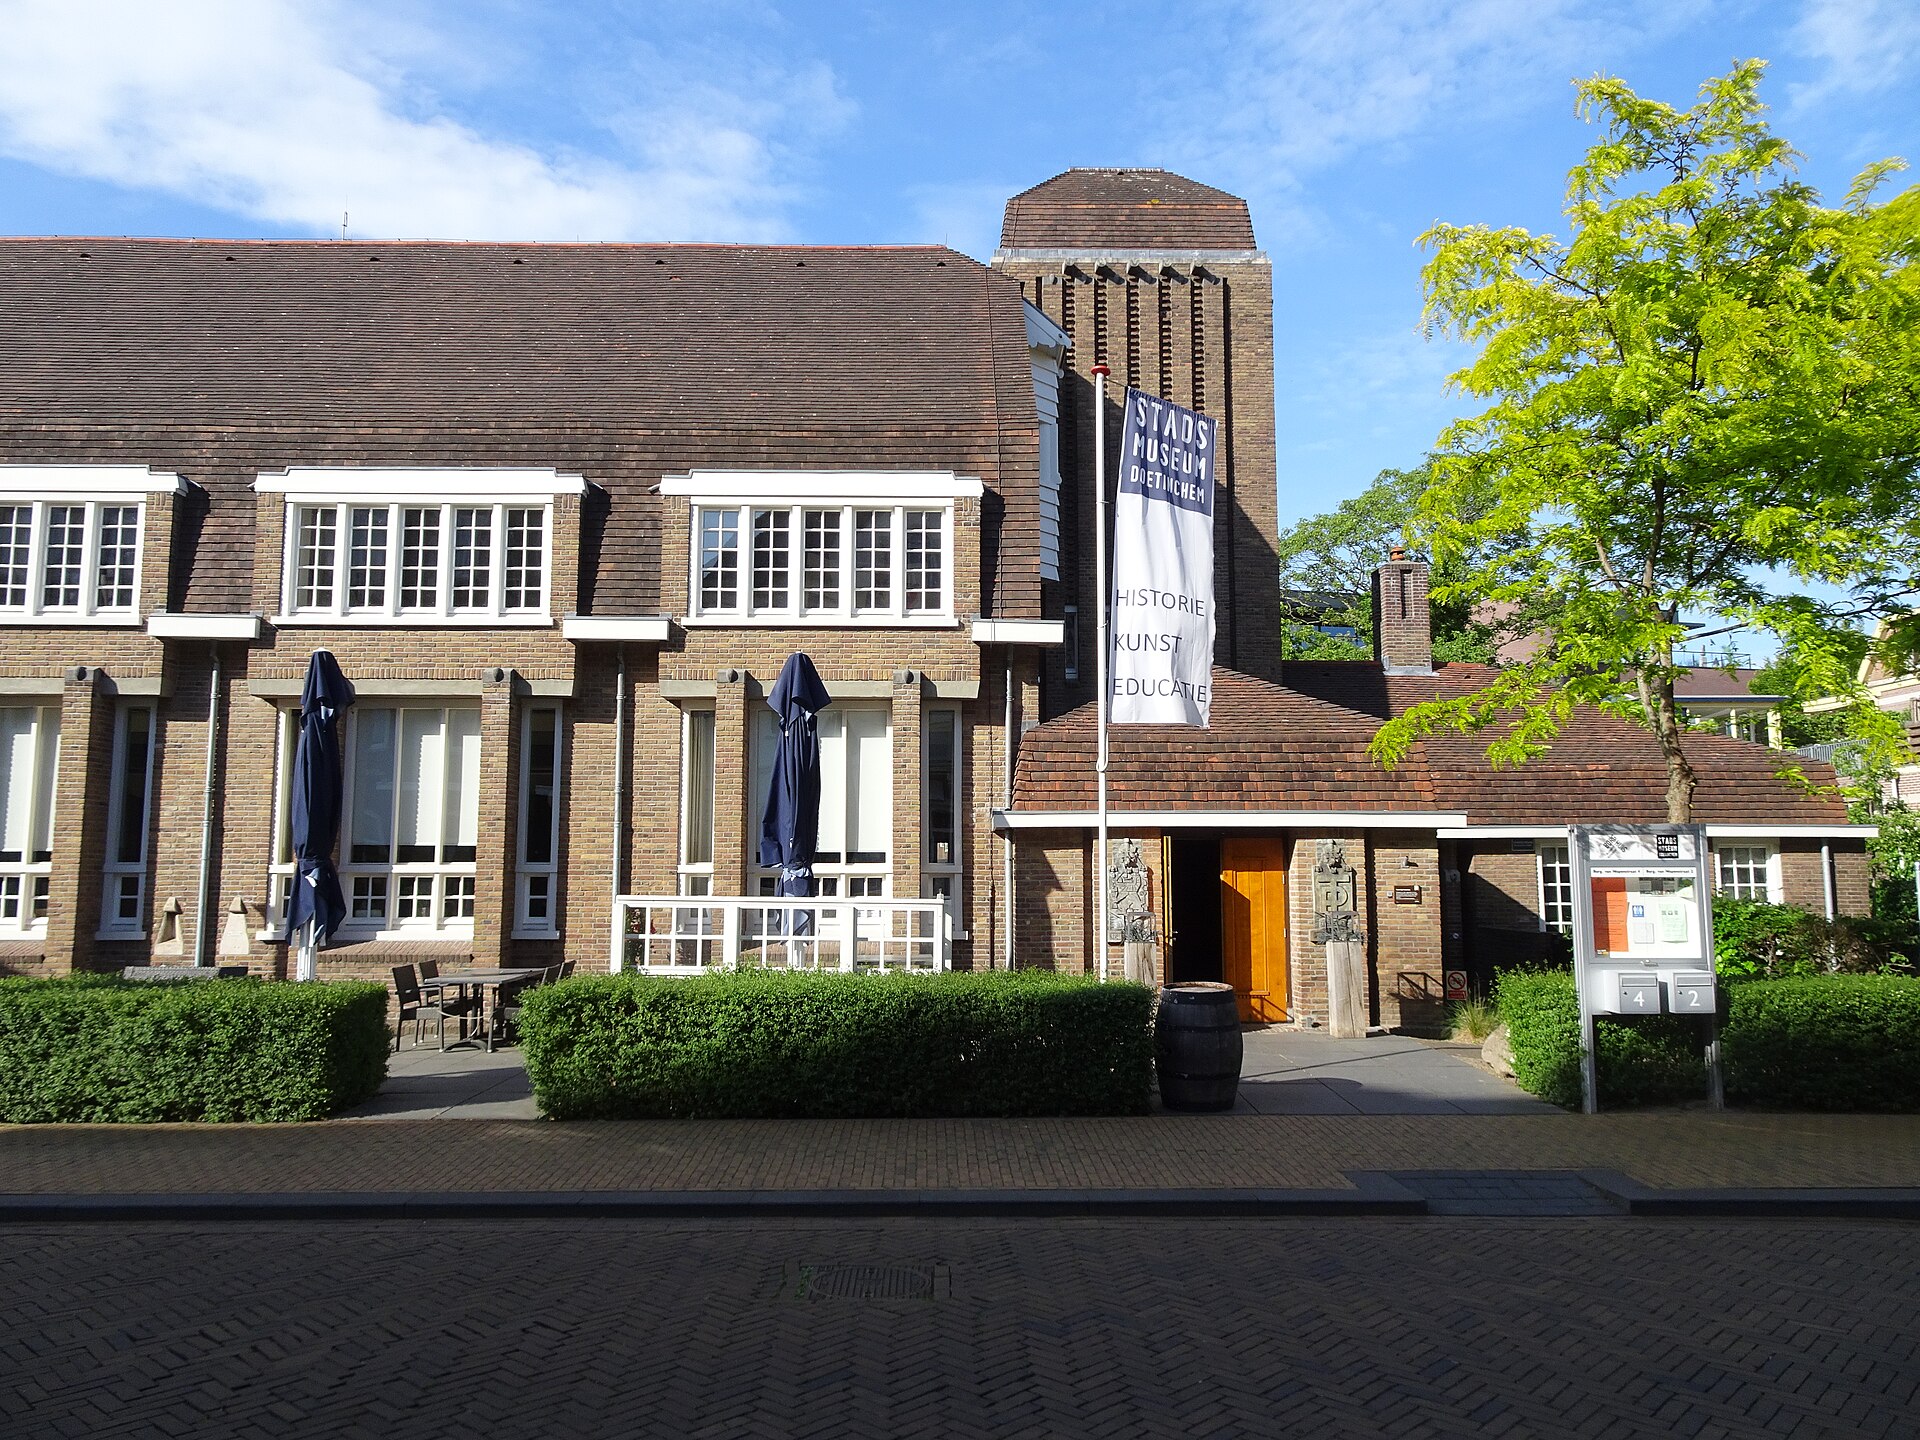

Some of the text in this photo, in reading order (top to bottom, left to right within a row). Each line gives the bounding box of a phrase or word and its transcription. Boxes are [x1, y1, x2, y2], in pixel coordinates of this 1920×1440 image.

[1135, 398, 1208, 449] STADS
[1132, 433, 1207, 480] MUSEUM
[1130, 465, 1205, 504] DOETINCHEM
[1115, 589, 1205, 616] HISTORIE
[1114, 632, 1183, 654] KUNST
[1113, 678, 1207, 703] EDUCATIE
[1633, 990, 1645, 1007] 4
[1688, 990, 1700, 1007] 2
